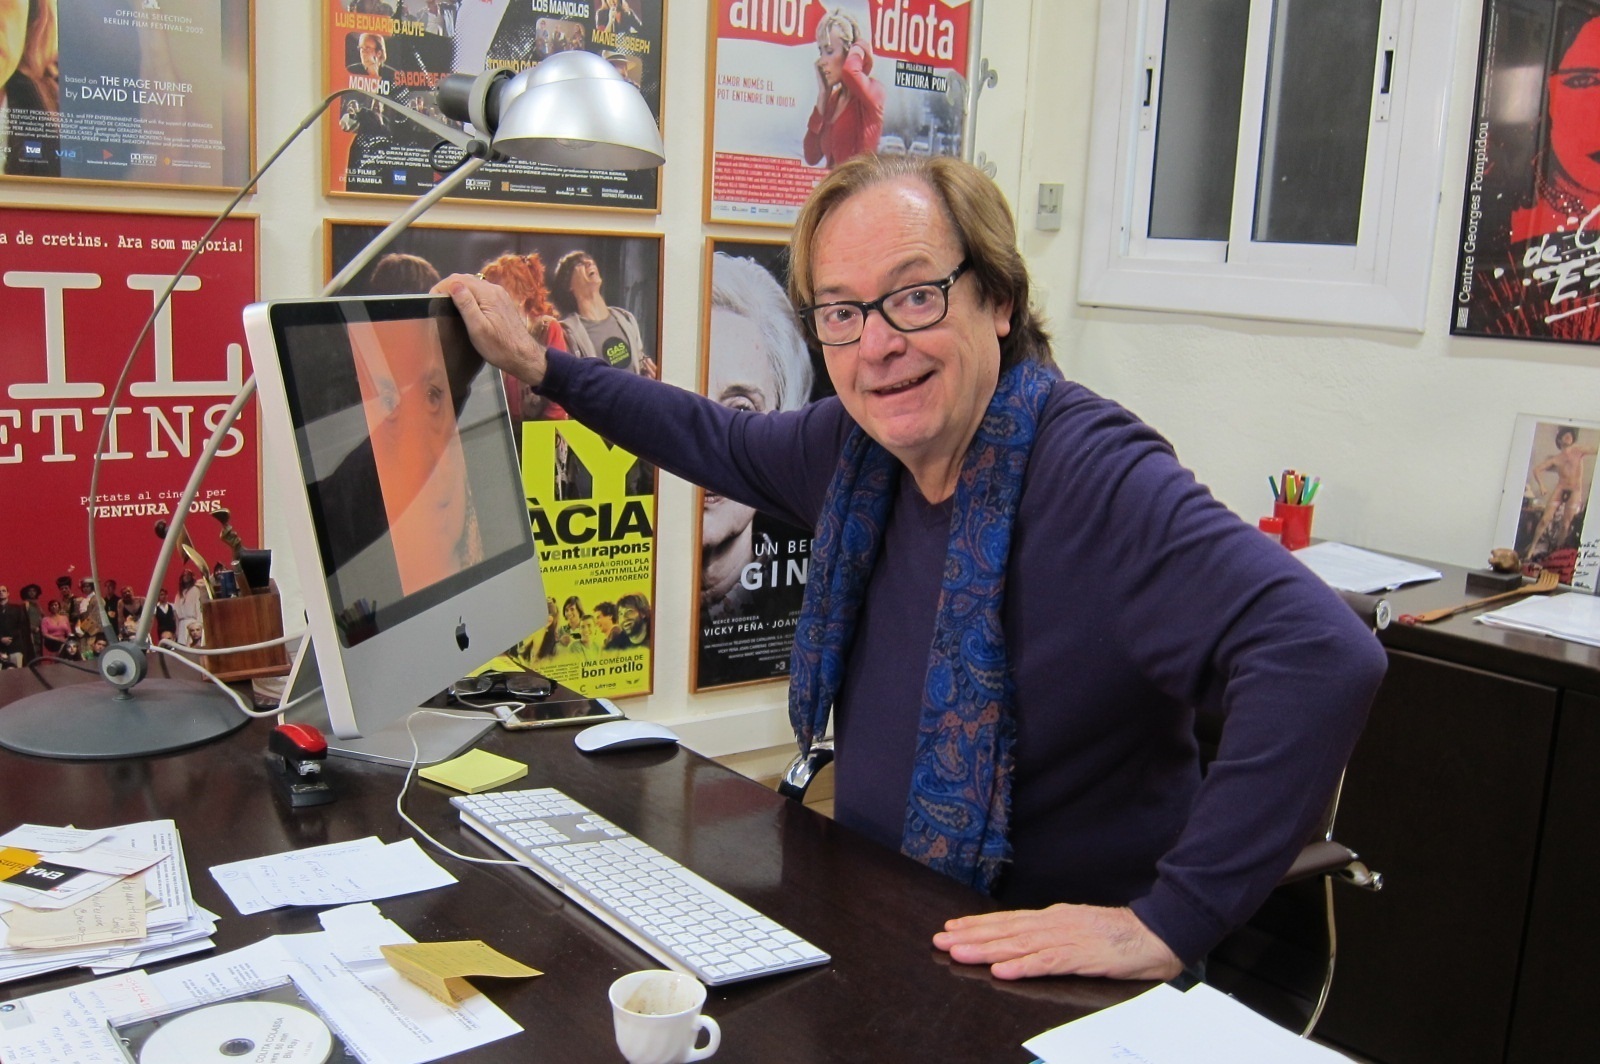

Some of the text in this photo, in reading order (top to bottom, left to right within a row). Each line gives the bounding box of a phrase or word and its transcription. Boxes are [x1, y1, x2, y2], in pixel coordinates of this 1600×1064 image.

[115, 9, 192, 24] OFFICIAL SELECTION
[531, 0, 590, 18] LOS MANOLOS
[103, 17, 130, 26] BERLIN
[150, 22, 184, 32] FESTIVAL
[335, 11, 426, 37] LUIS EDUARDO AUTE
[729, 0, 813, 39] amor
[875, 0, 955, 61] idiota
[64, 75, 87, 84] based
[100, 75, 120, 87] THE
[123, 78, 151, 89] PAGE
[153, 81, 193, 94] TURNER
[348, 75, 391, 96] MONCHO
[394, 71, 427, 86] SABOR
[718, 74, 775, 92] L'AMOR NOMÉS EL
[896, 72, 947, 92] VENTURA PON
[65, 86, 186, 107] by DAVID LEAVITT
[717, 88, 729, 101] POT
[732, 90, 763, 105] ENTENDRE
[1470, 122, 1490, 192] Pompidou
[348, 176, 383, 185] LA RAMBLA
[357, 169, 377, 177] FILMS
[1464, 193, 1484, 255] Georges
[16, 231, 35, 246] de
[42, 231, 109, 248] cretins.
[118, 235, 144, 249] Ara
[150, 238, 176, 250] som
[182, 236, 244, 253] majoria!
[1522, 233, 1562, 268] de
[1458, 257, 1475, 304] Centre
[80, 487, 227, 506] portats al cinea per
[85, 501, 169, 519] VENTURA
[540, 542, 651, 562] venturapons
[754, 541, 779, 557] UN
[549, 564, 577, 575] MARIA
[578, 560, 605, 572] SARDÀ
[634, 558, 650, 567] PLA
[620, 564, 650, 575] MILLÁN
[739, 556, 809, 592] GIN
[614, 574, 649, 583] MORENO
[704, 617, 799, 637] VICKY PEÑA JOAN
[732, 616, 760, 624] RODOREDA
[581, 660, 598, 668] UNA
[634, 654, 644, 662] DE
[581, 667, 606, 679] bon
[609, 661, 644, 675] rotllo
[25, 866, 66, 881] EMA
[256, 1043, 273, 1064] COLITA
